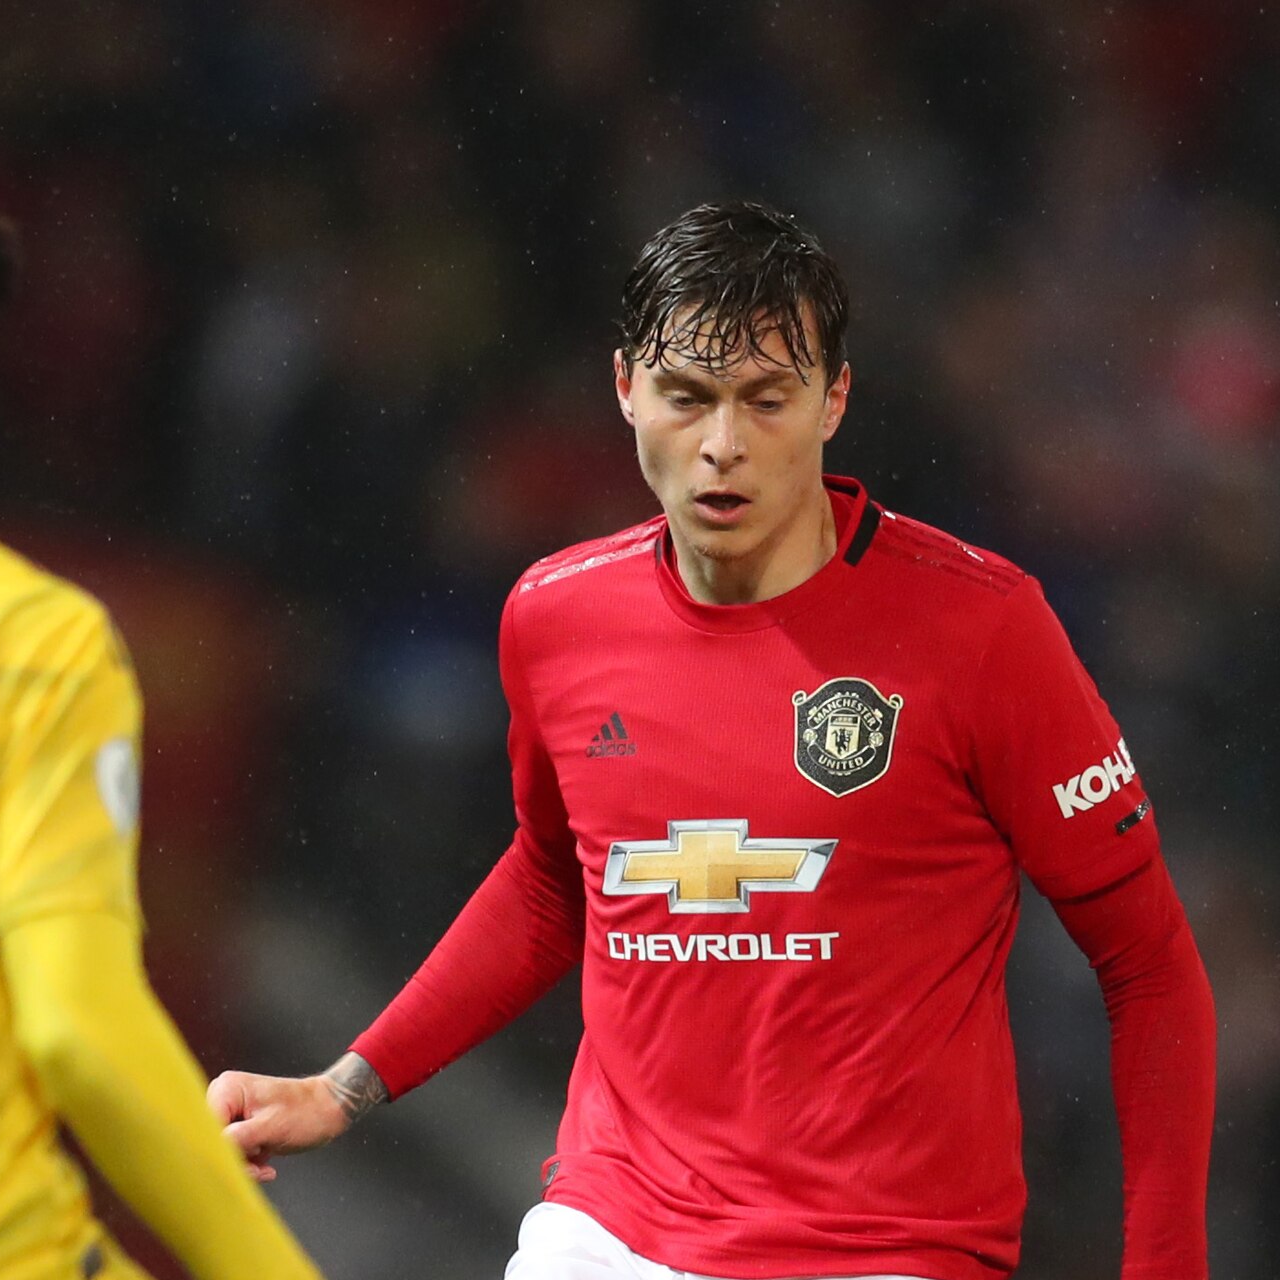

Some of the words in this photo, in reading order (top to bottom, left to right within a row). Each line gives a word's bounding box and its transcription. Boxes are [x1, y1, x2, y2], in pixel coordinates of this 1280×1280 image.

[814, 698, 878, 727] MANCHESTER
[817, 756, 864, 770] UNITED
[607, 931, 841, 962] CHEVROLET
